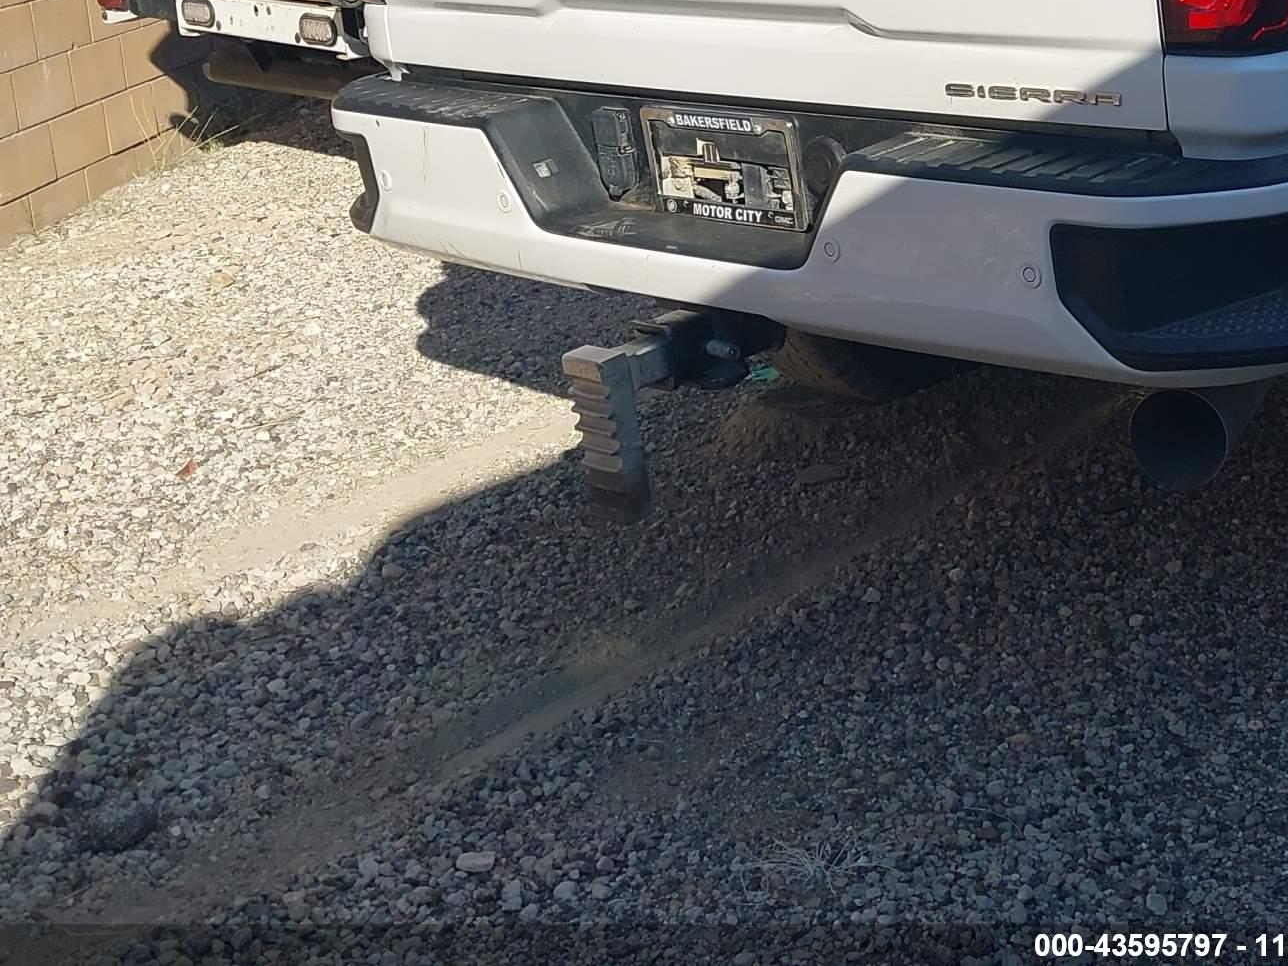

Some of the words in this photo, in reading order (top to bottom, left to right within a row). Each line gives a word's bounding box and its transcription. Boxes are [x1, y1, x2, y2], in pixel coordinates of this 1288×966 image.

[944, 83, 1122, 106] SIERRA
[675, 114, 752, 133] BAKERSFIELD
[693, 203, 732, 221] MOTOR
[735, 207, 763, 223] CITY
